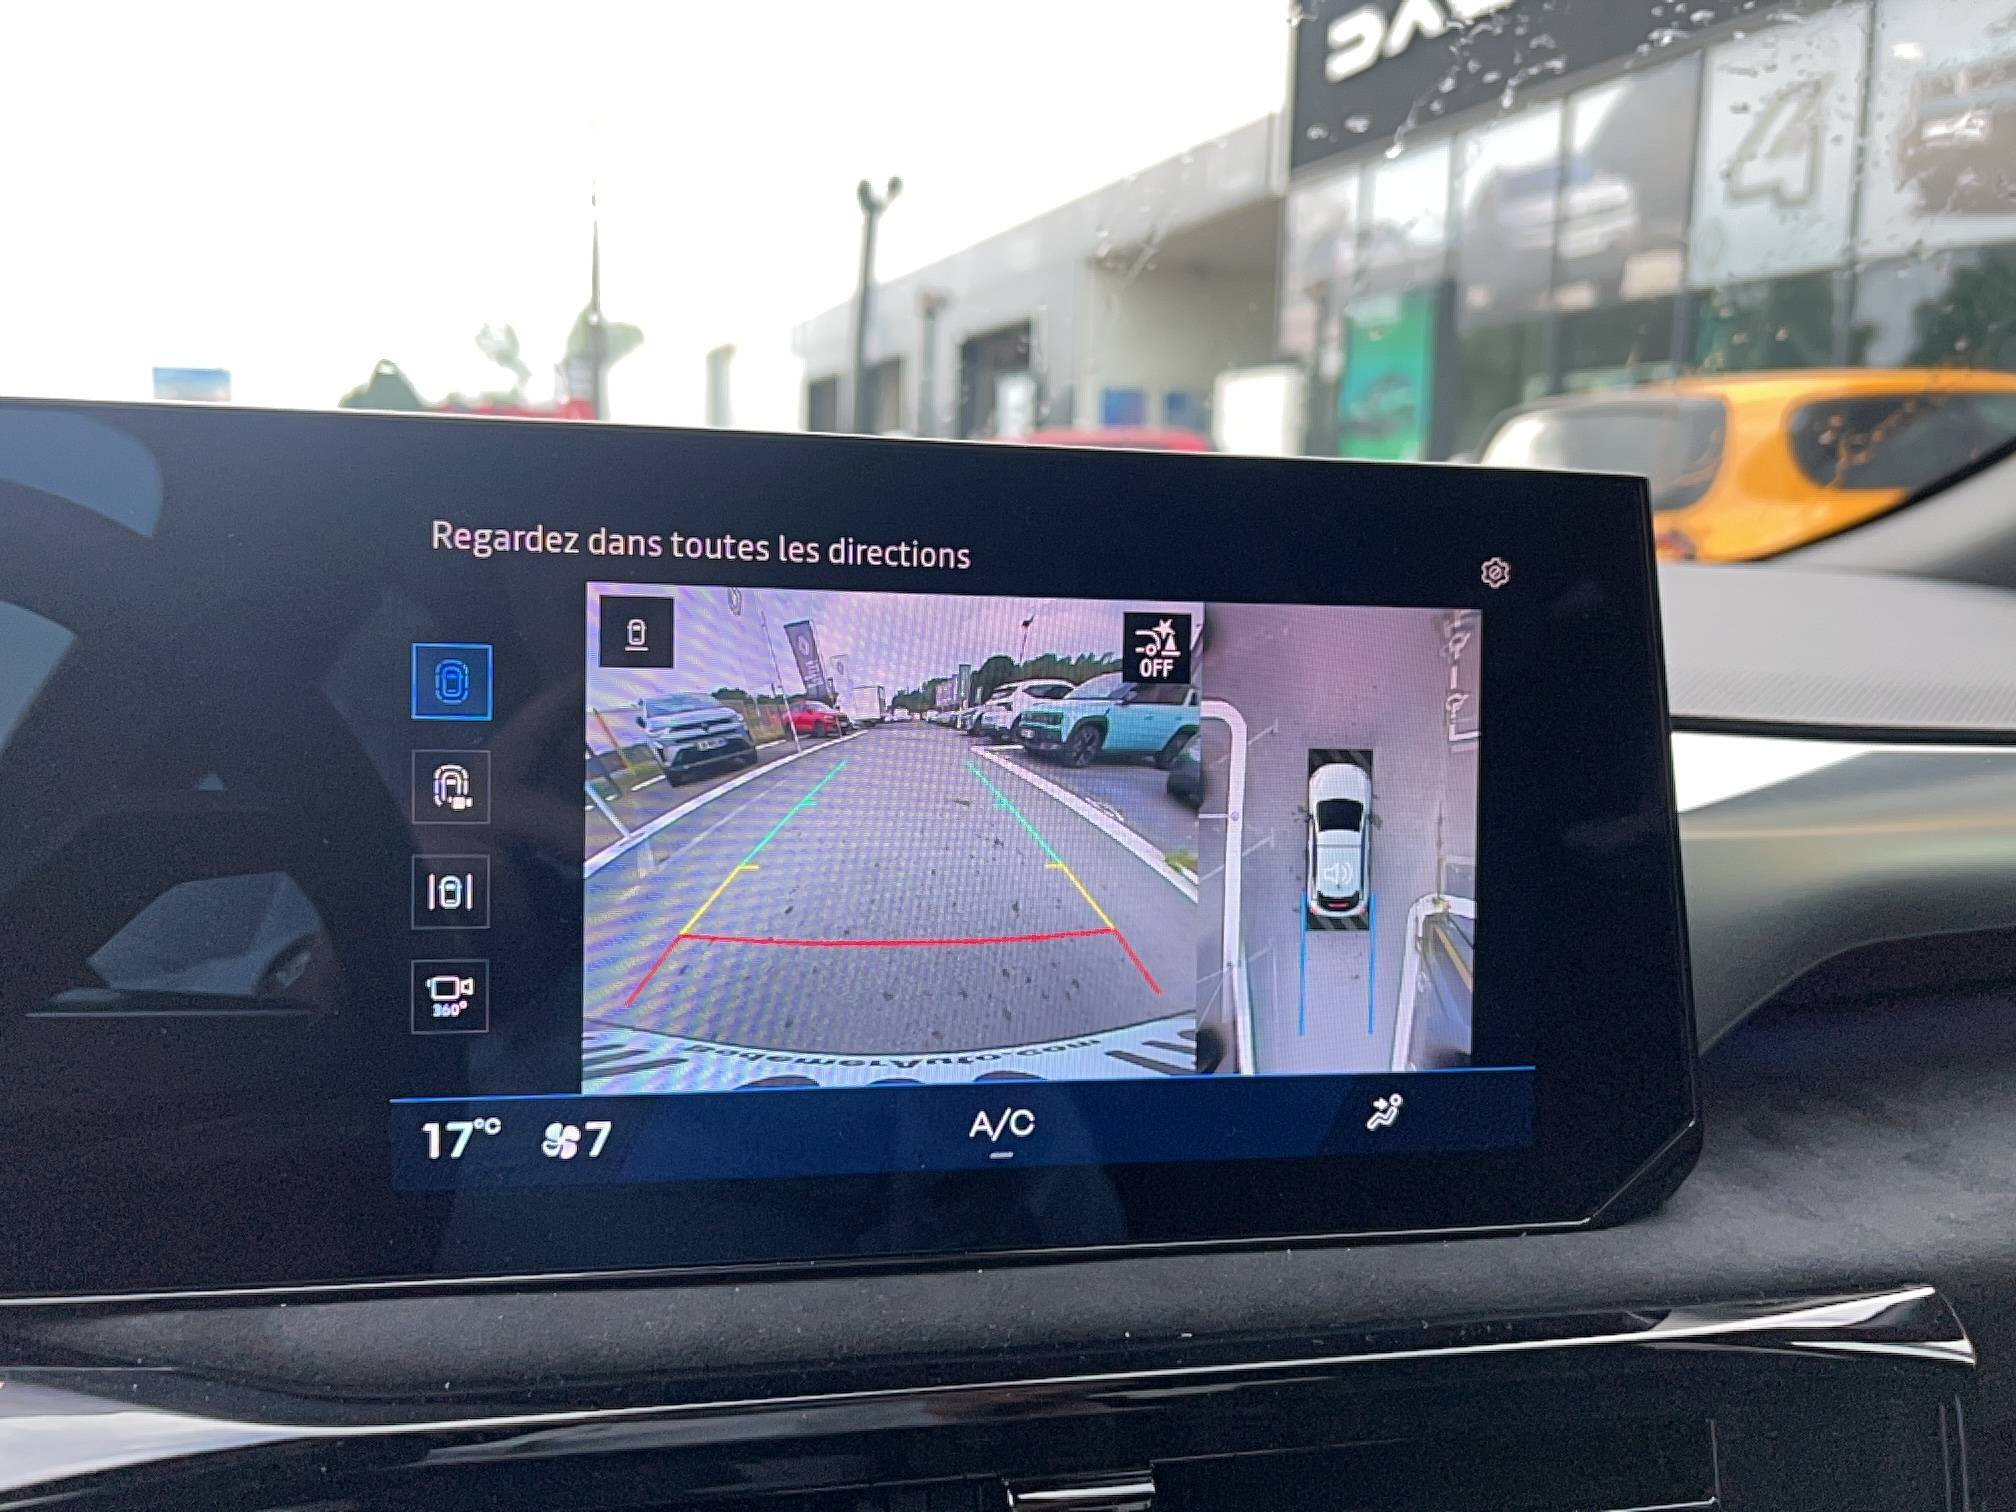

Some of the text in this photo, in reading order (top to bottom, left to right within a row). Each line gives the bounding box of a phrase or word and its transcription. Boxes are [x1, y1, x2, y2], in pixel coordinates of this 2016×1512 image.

[431, 519, 972, 570] Regardez dans toutes les directions
[1139, 658, 1174, 678] OFF
[421, 1116, 502, 1160] 17°C
[584, 1120, 612, 1158] 7
[968, 1107, 1036, 1143] A/C
